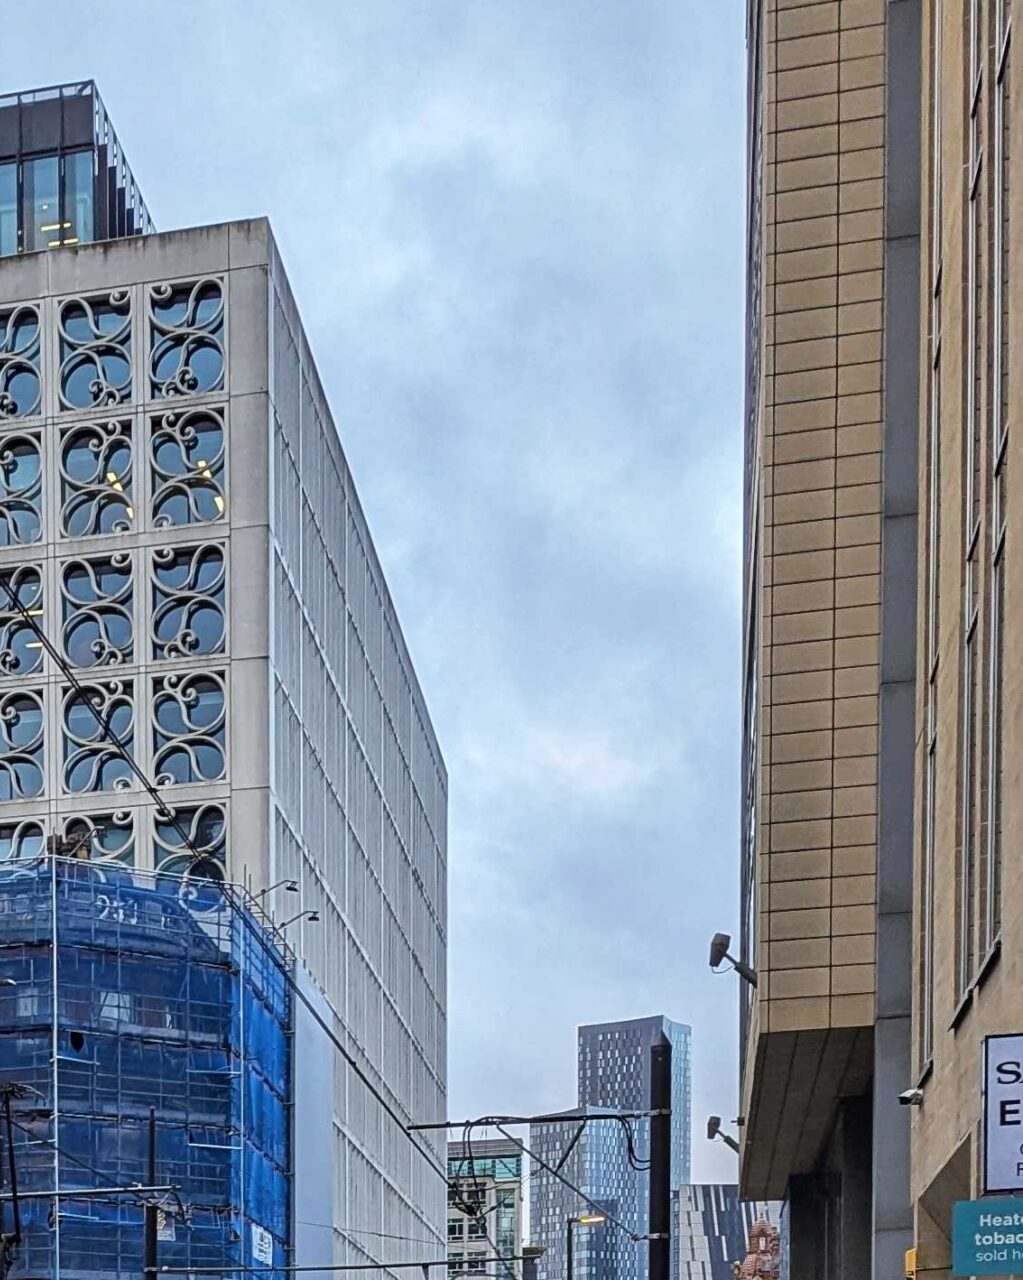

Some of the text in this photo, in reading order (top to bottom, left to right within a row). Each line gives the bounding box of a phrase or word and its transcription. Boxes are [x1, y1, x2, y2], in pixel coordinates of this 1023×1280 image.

[996, 1061, 1023, 1085] S
[976, 1249, 1023, 1262] sold h
